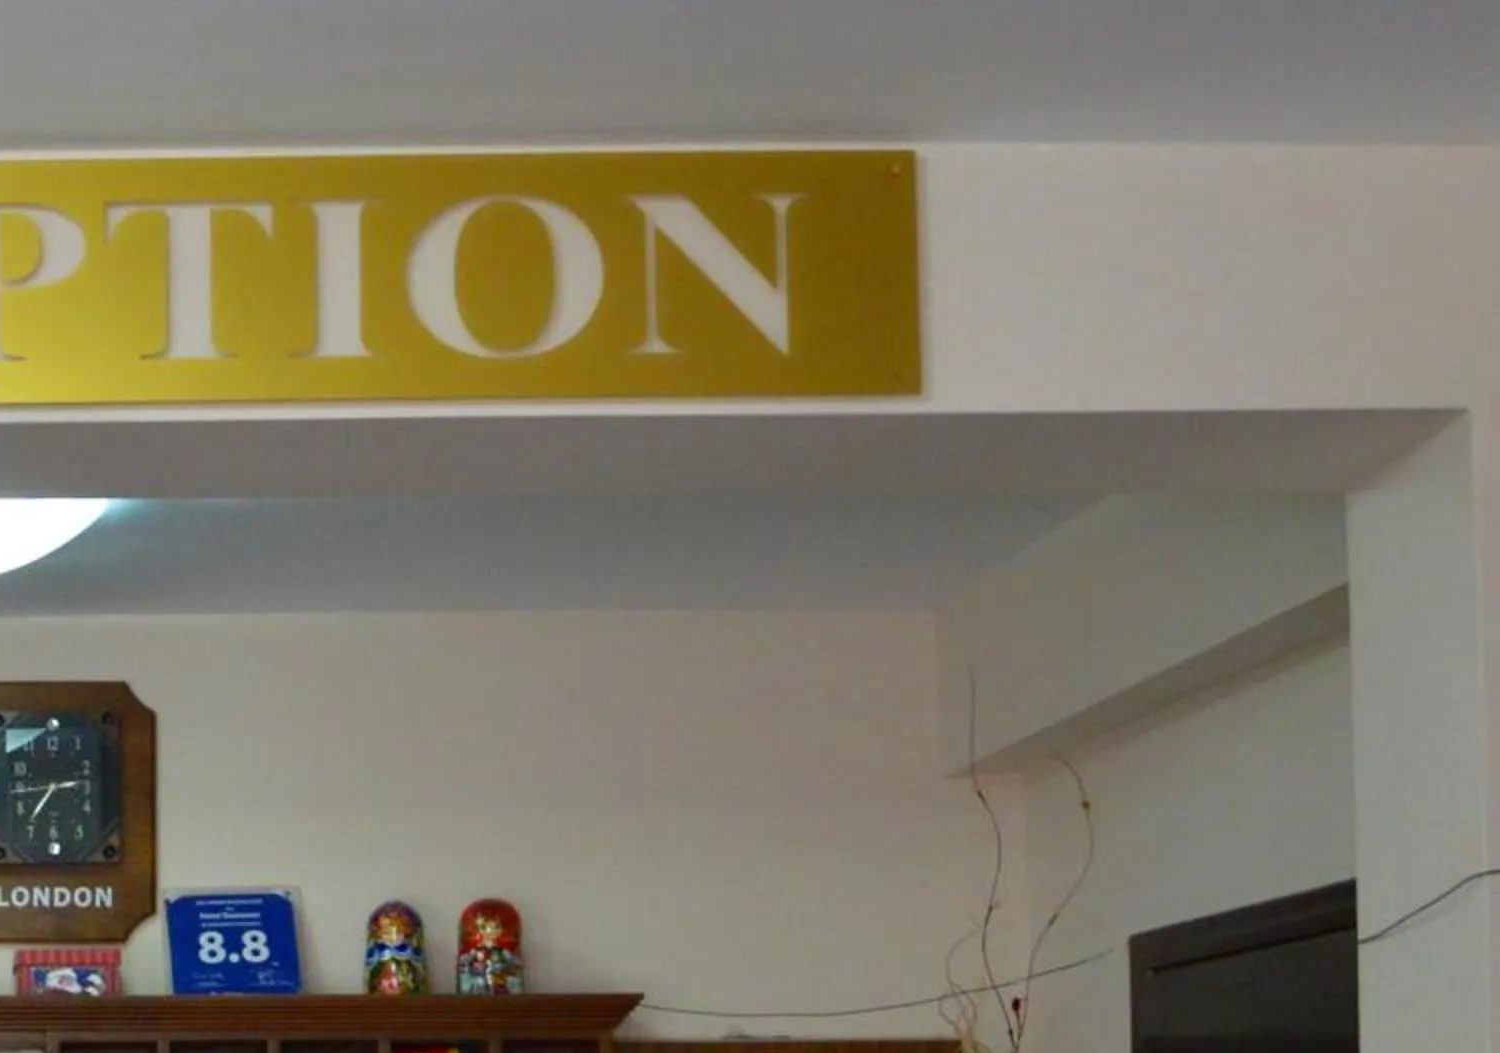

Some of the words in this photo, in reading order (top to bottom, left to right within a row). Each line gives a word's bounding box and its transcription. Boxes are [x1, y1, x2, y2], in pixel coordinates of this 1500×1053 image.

[46, 736, 59, 751] 12
[13, 762, 27, 776] 10
[199, 930, 269, 964] 8.8
